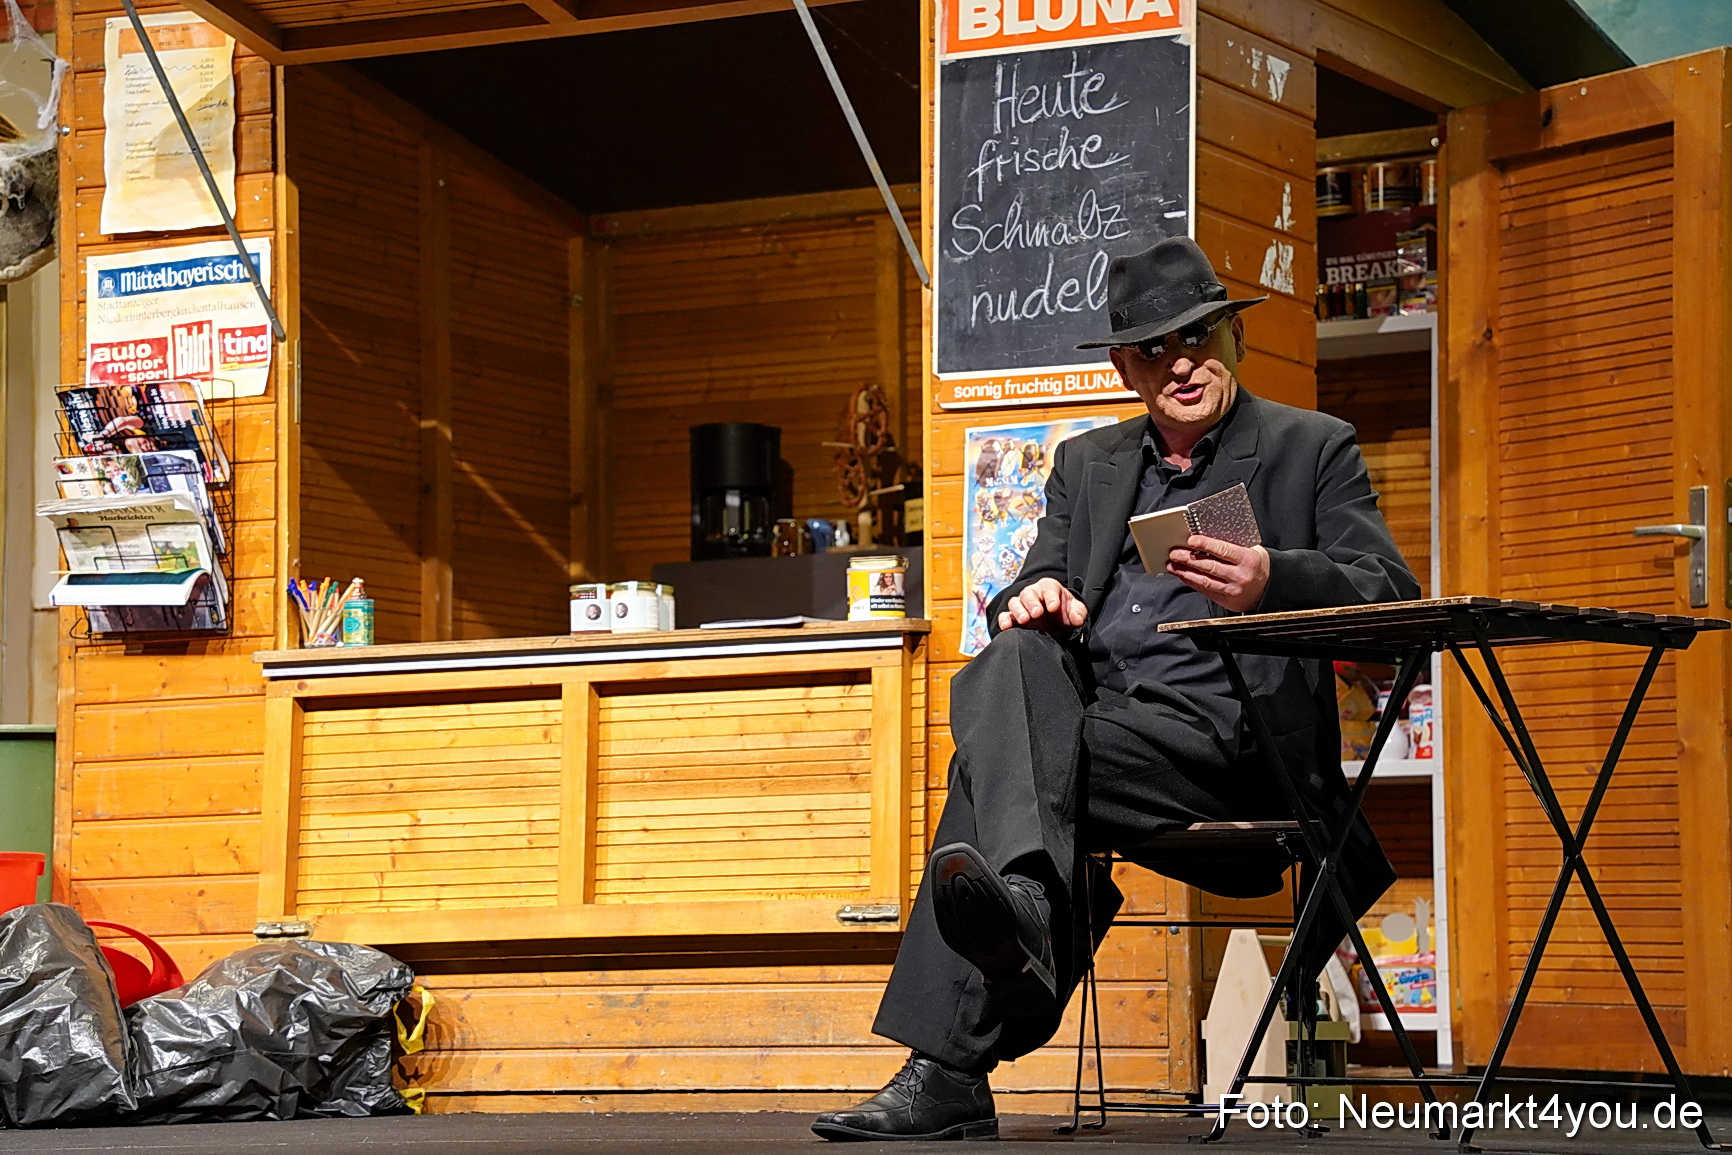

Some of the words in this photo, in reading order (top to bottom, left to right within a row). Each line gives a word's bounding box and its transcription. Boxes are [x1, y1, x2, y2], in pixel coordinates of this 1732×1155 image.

[993, 51, 1129, 134] Heute
[968, 126, 1130, 201] frische
[97, 297, 159, 311] Stadtanzeiger
[93, 343, 152, 362] auto
[174, 324, 210, 377] Bild
[107, 357, 163, 373] motor
[954, 381, 1002, 399] sonnig
[1004, 377, 1062, 395] fruchtig
[1064, 372, 1124, 391] BLUNA
[97, 514, 155, 522] Nachrichten
